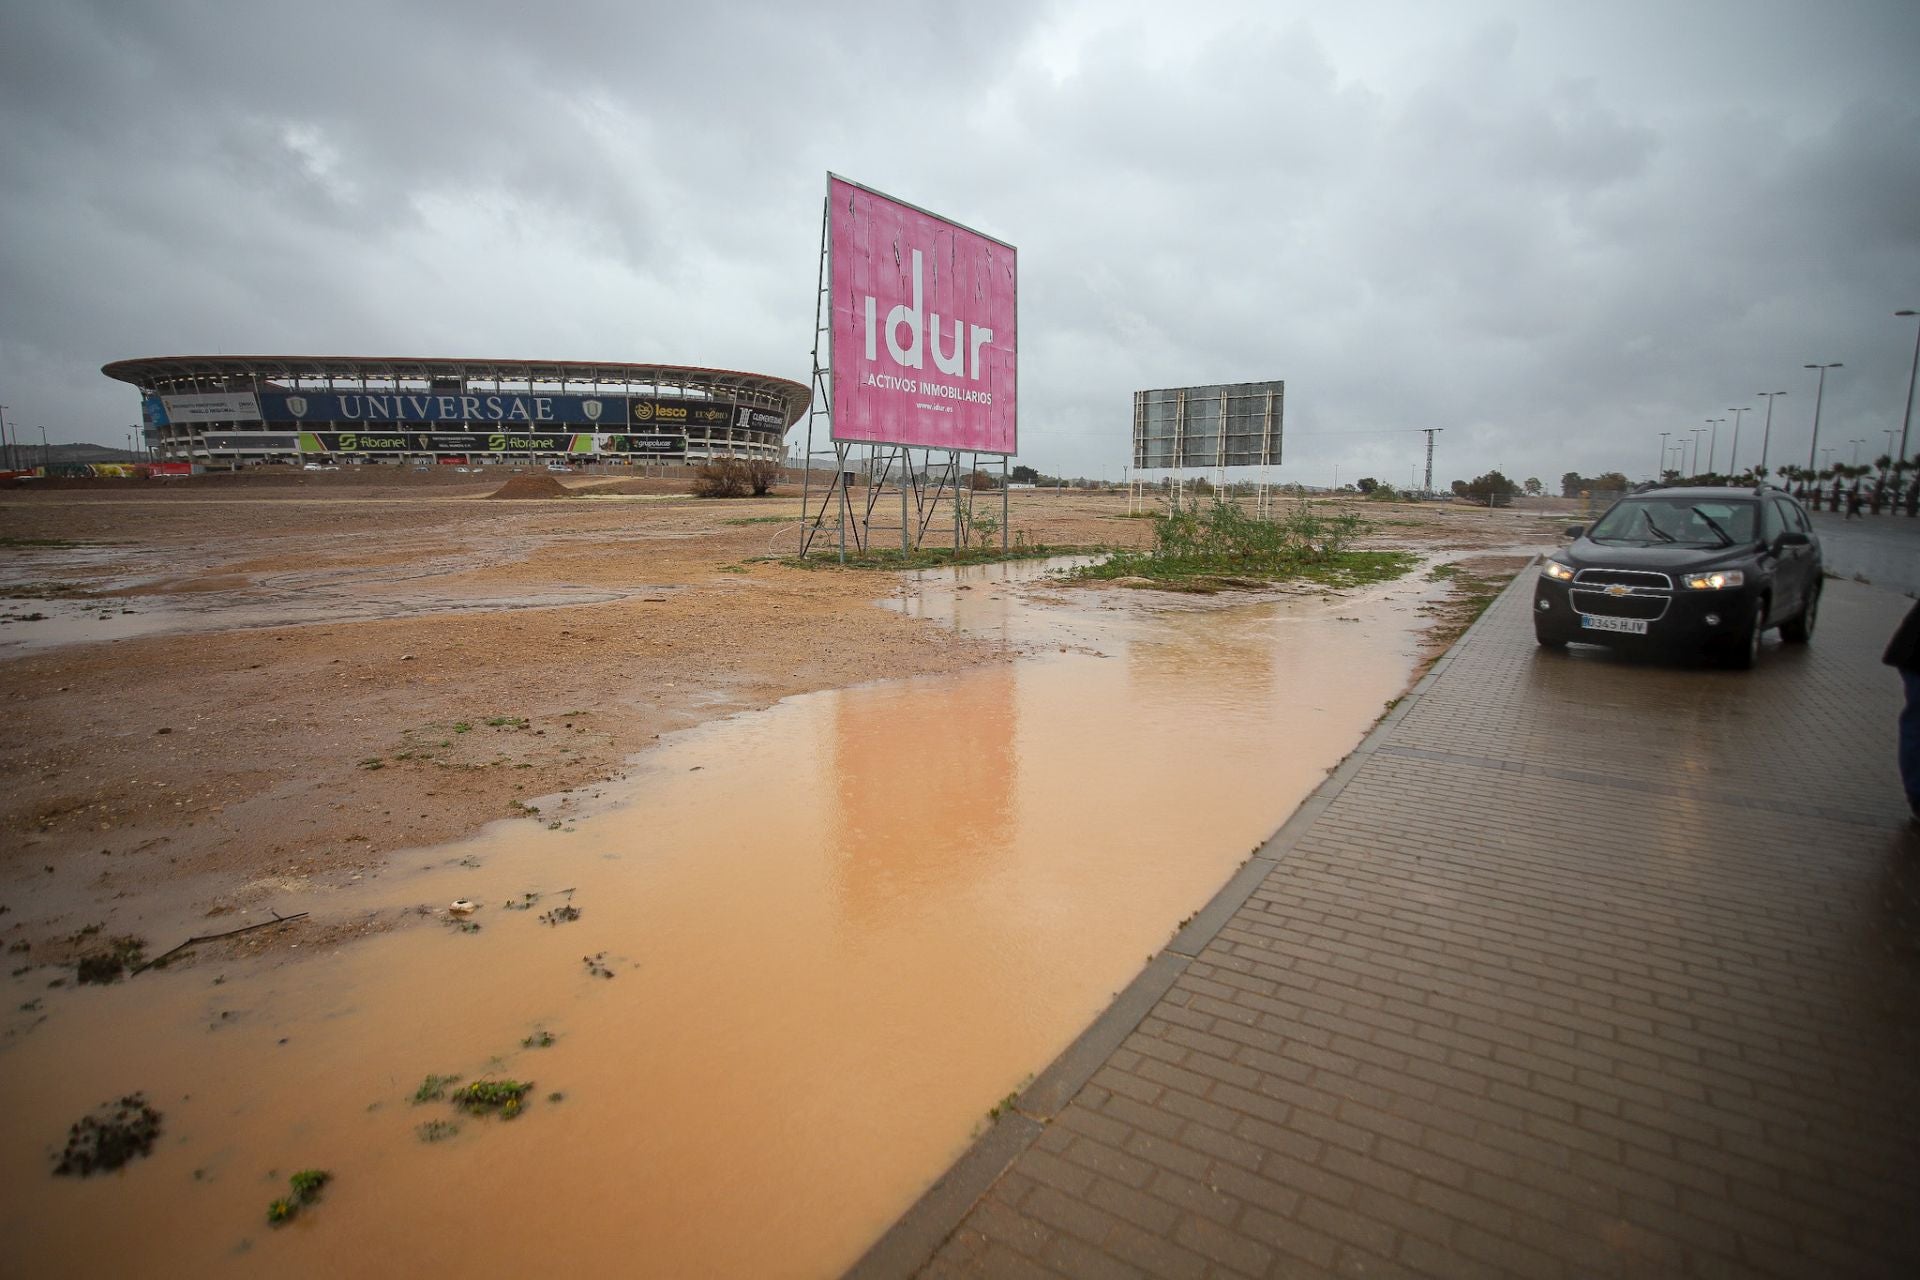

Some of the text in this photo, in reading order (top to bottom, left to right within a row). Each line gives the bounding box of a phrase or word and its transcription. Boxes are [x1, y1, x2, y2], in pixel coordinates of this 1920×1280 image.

[865, 248, 993, 380] idur
[867, 374, 992, 405] ACTIVOS INMOBILIARIOS
[338, 395, 555, 421] UNIVERSAE
[655, 404, 687, 417] lesco
[916, 403, 954, 413] www.idur.es
[360, 436, 407, 448] fibranet
[509, 438, 554, 449] fibranet
